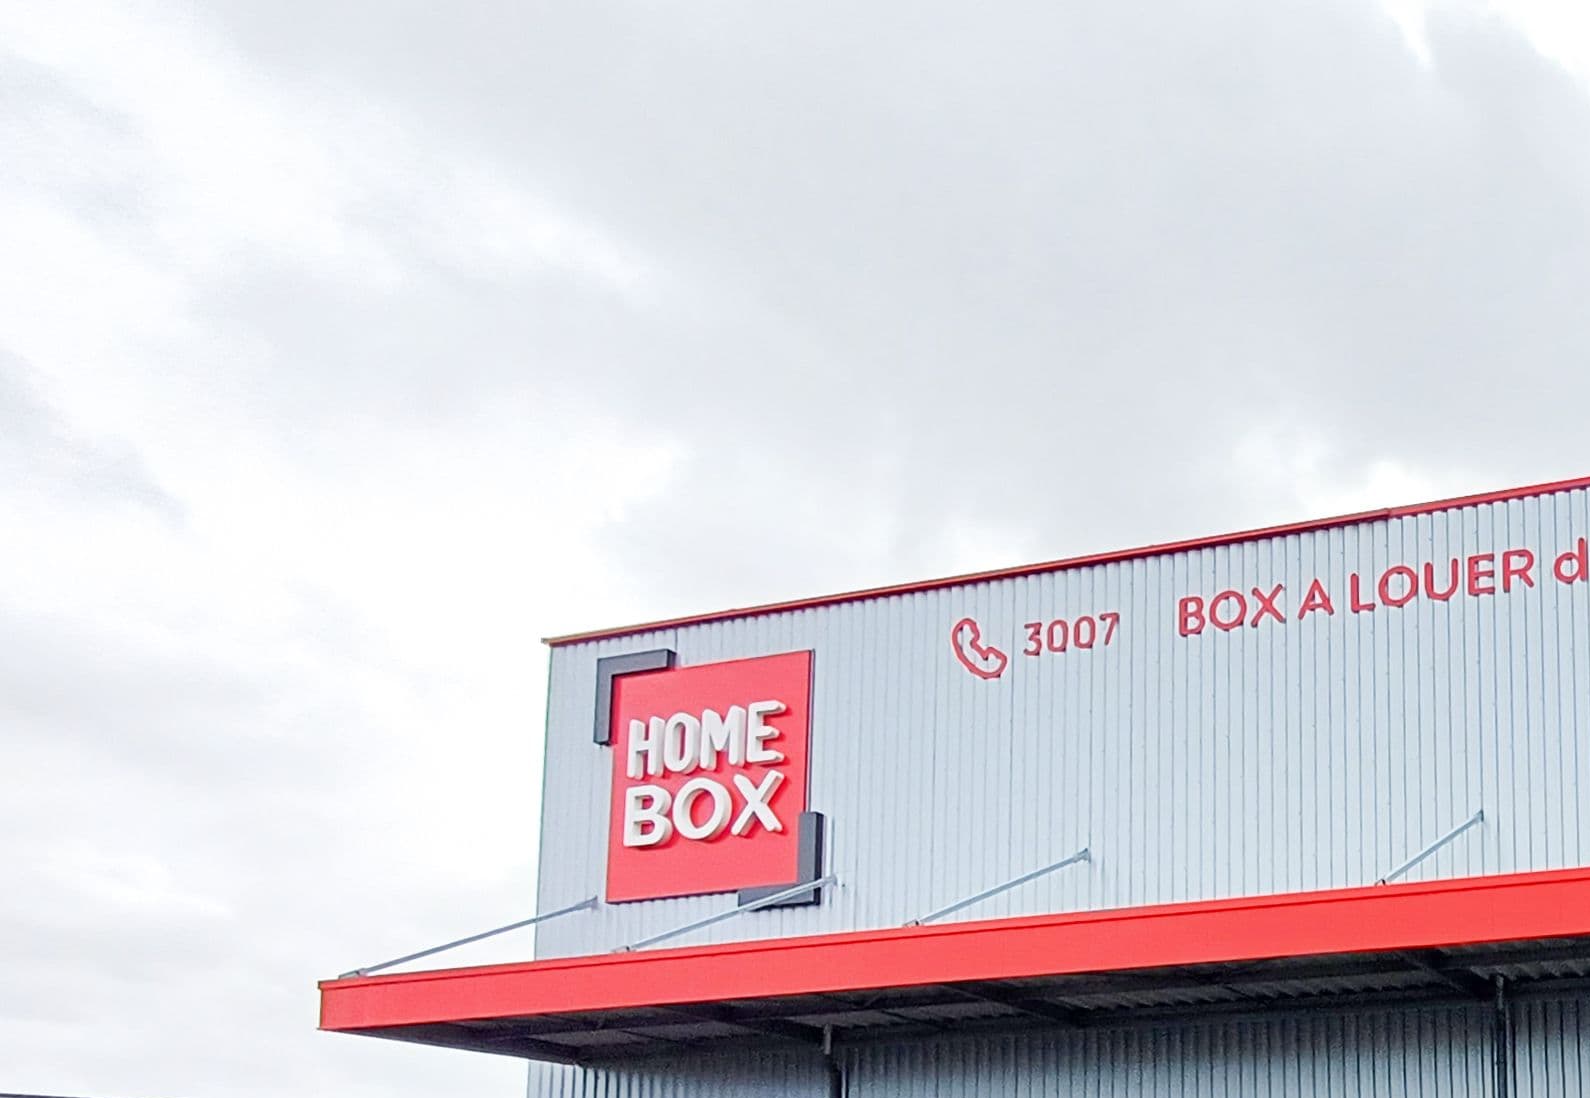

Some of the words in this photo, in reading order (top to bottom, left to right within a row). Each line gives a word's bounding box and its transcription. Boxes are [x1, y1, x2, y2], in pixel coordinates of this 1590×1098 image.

[1178, 583, 1286, 637] BOX
[1297, 578, 1334, 620] A
[1350, 549, 1534, 613] LOUER
[1024, 612, 1119, 656] 3007
[626, 700, 786, 779] HOME
[623, 769, 784, 847] BOX
